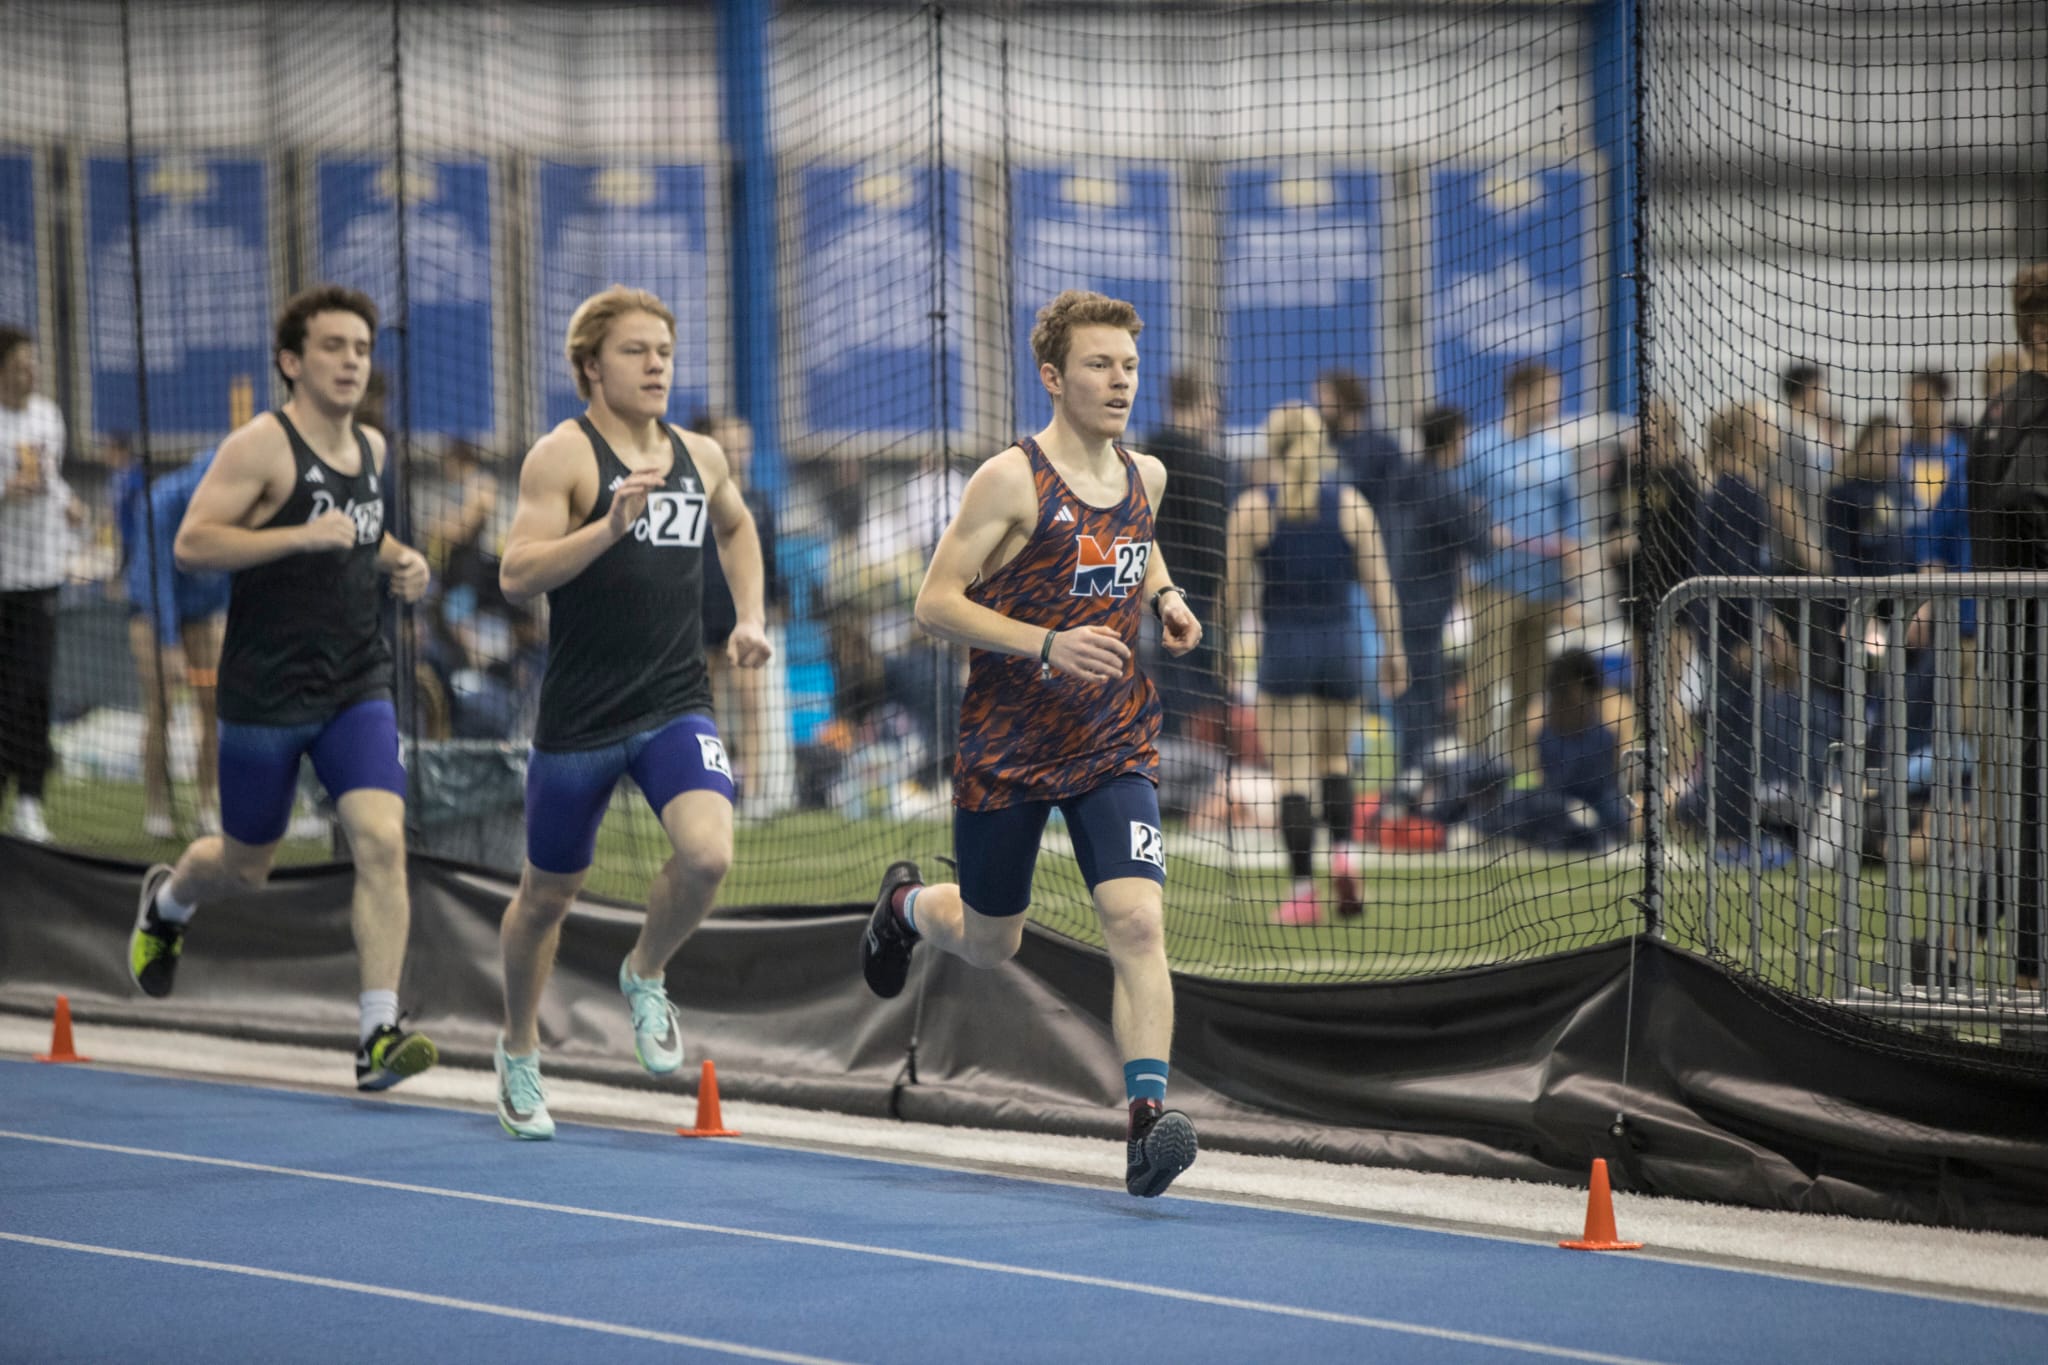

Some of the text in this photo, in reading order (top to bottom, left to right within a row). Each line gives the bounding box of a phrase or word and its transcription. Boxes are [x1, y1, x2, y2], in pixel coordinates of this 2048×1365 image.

[653, 498, 703, 541] 27
[1069, 535, 1132, 598] M
[1118, 545, 1147, 584] 23
[1135, 825, 1164, 868] 23
